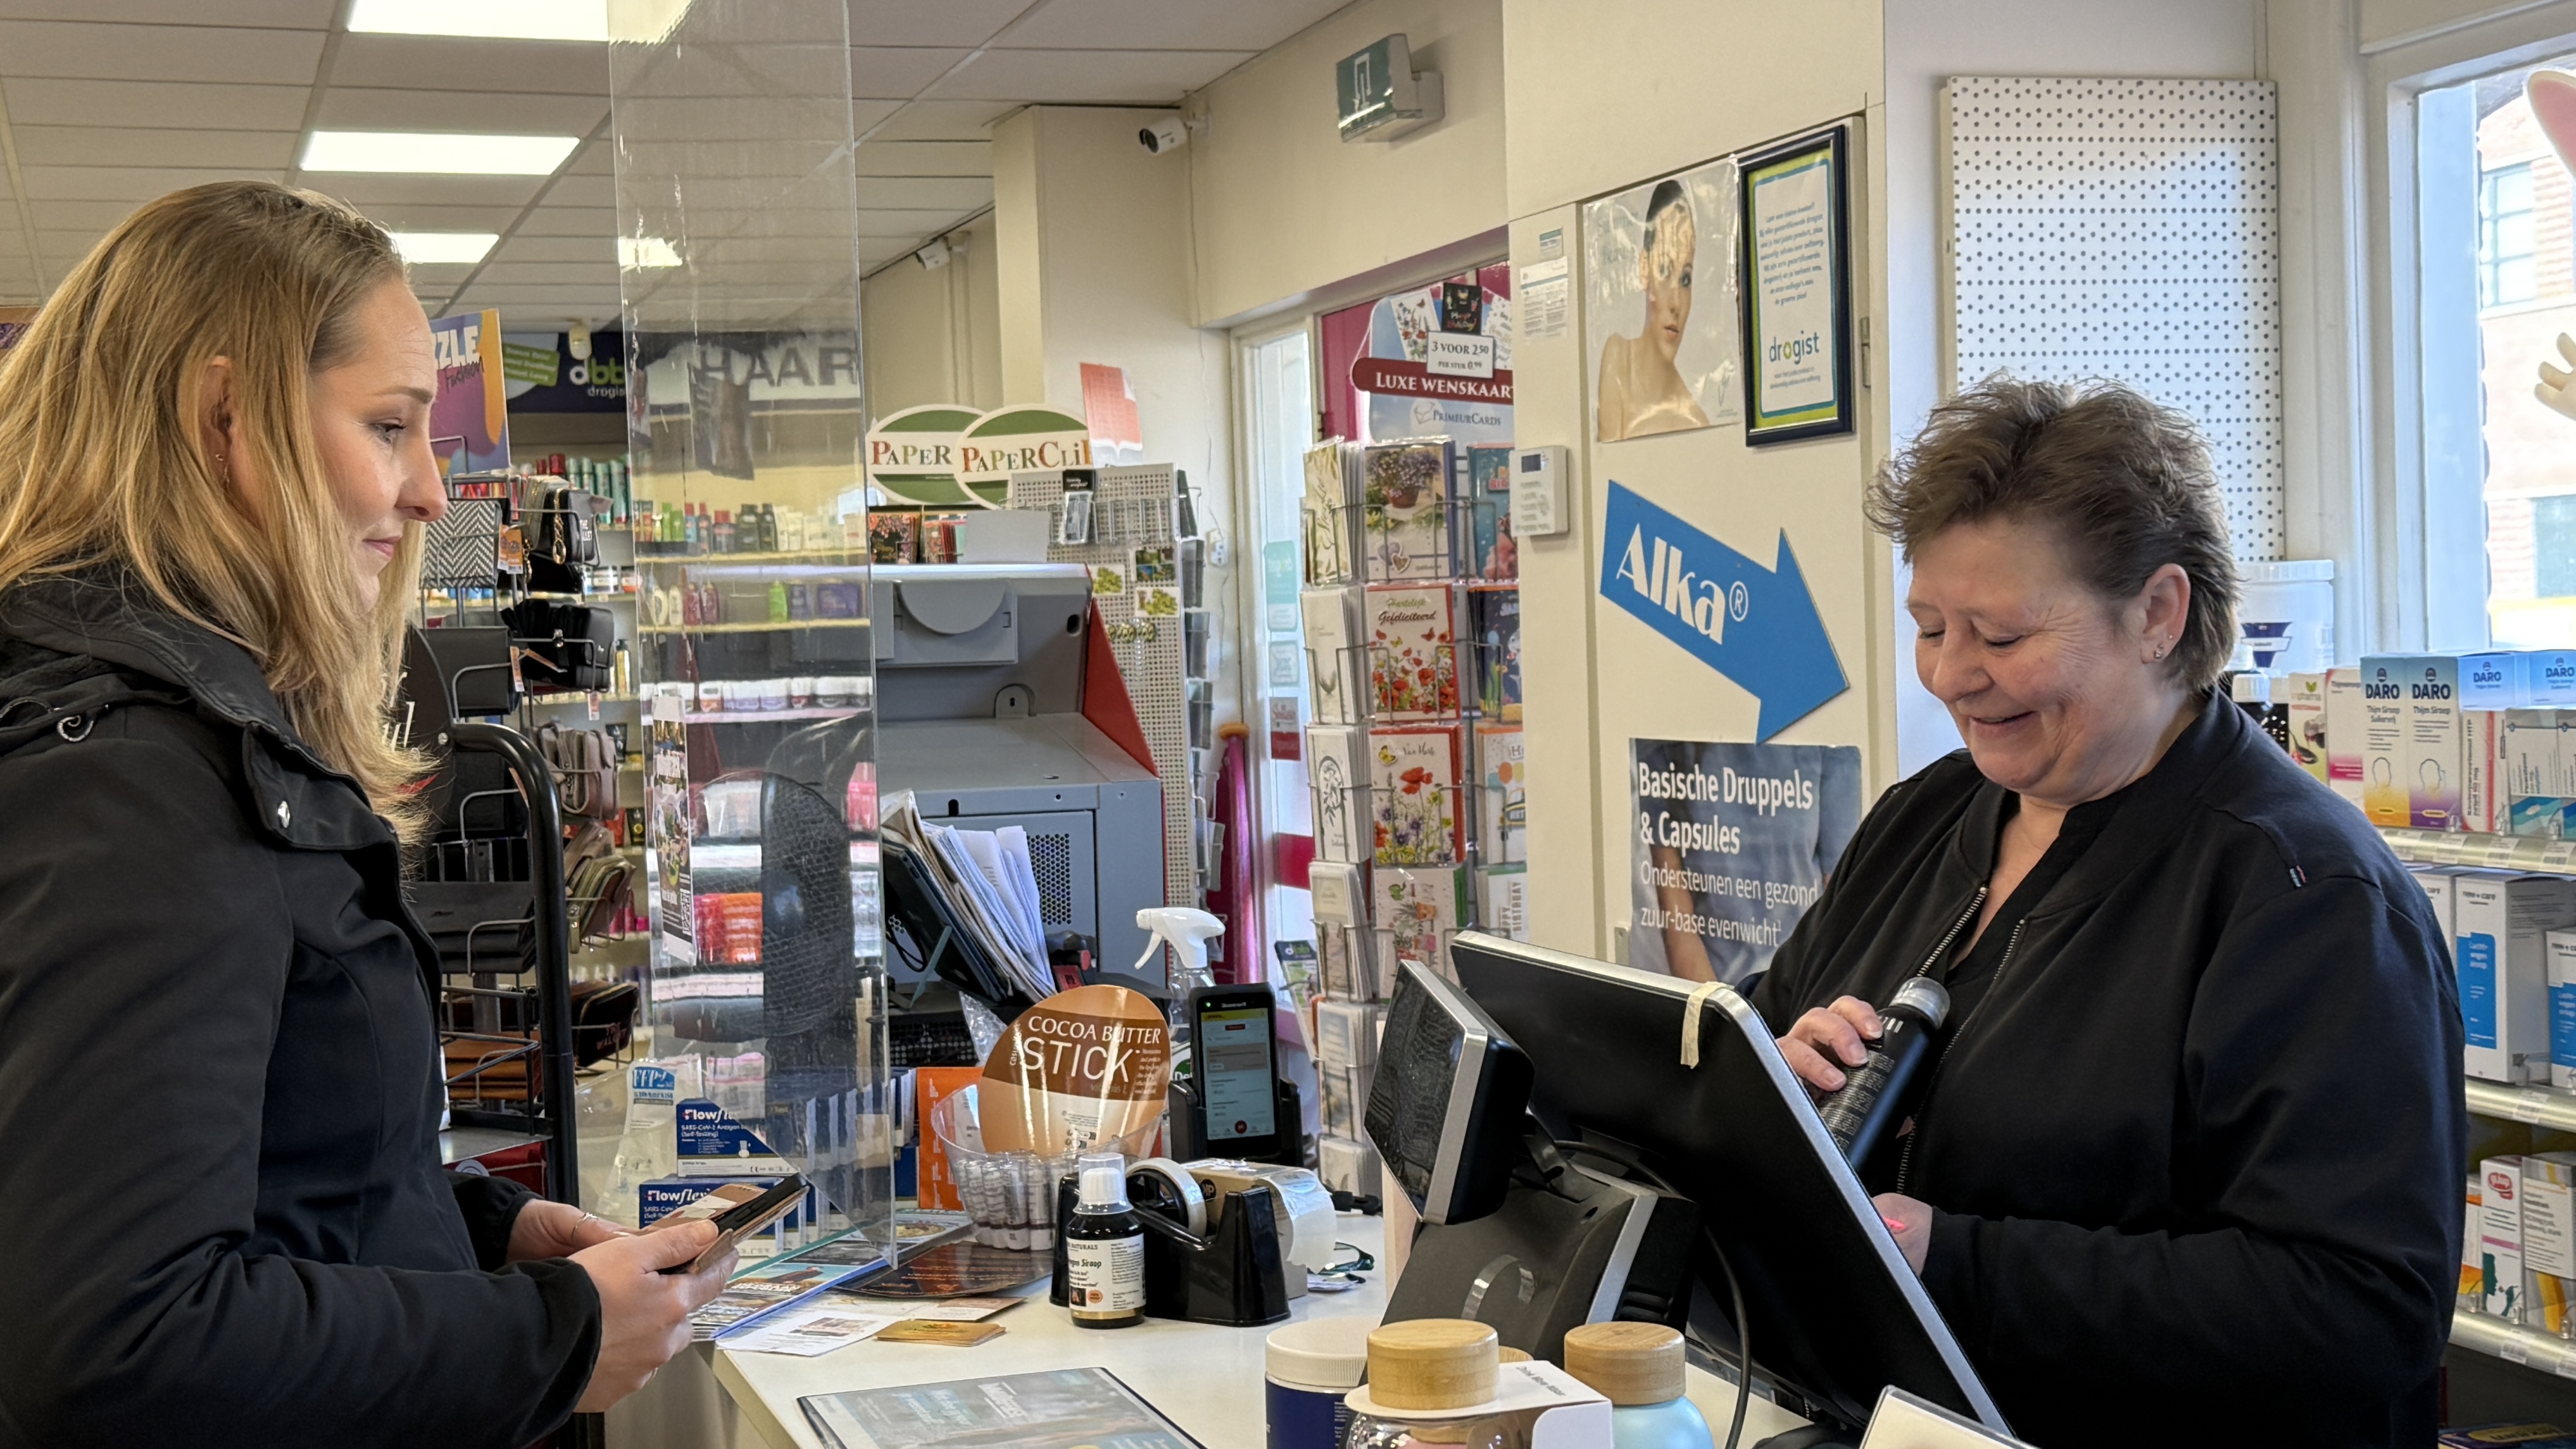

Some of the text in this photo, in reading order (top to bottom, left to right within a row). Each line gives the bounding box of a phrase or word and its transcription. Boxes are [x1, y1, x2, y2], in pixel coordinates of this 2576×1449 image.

[432, 325, 481, 370] ZLE
[1431, 341, 1439, 352] 3
[1440, 343, 1470, 355] VOOR
[1769, 329, 1820, 365] drogist
[699, 345, 858, 387] HAAR
[1376, 372, 1417, 390] LUXE
[2474, 672, 2501, 683] DARO
[2546, 667, 2575, 677] DARO
[2365, 683, 2400, 699] DARO
[2412, 683, 2451, 700] DARO
[1639, 762, 1813, 817] Basische Druppels
[1641, 810, 1741, 858] & Capsules
[1641, 860, 1818, 909] Ondersteunen een gezond
[1641, 904, 1705, 935] zuur-base
[1028, 1016, 1161, 1044] COCOA BUTTER
[1023, 1036, 1134, 1083] STICK
